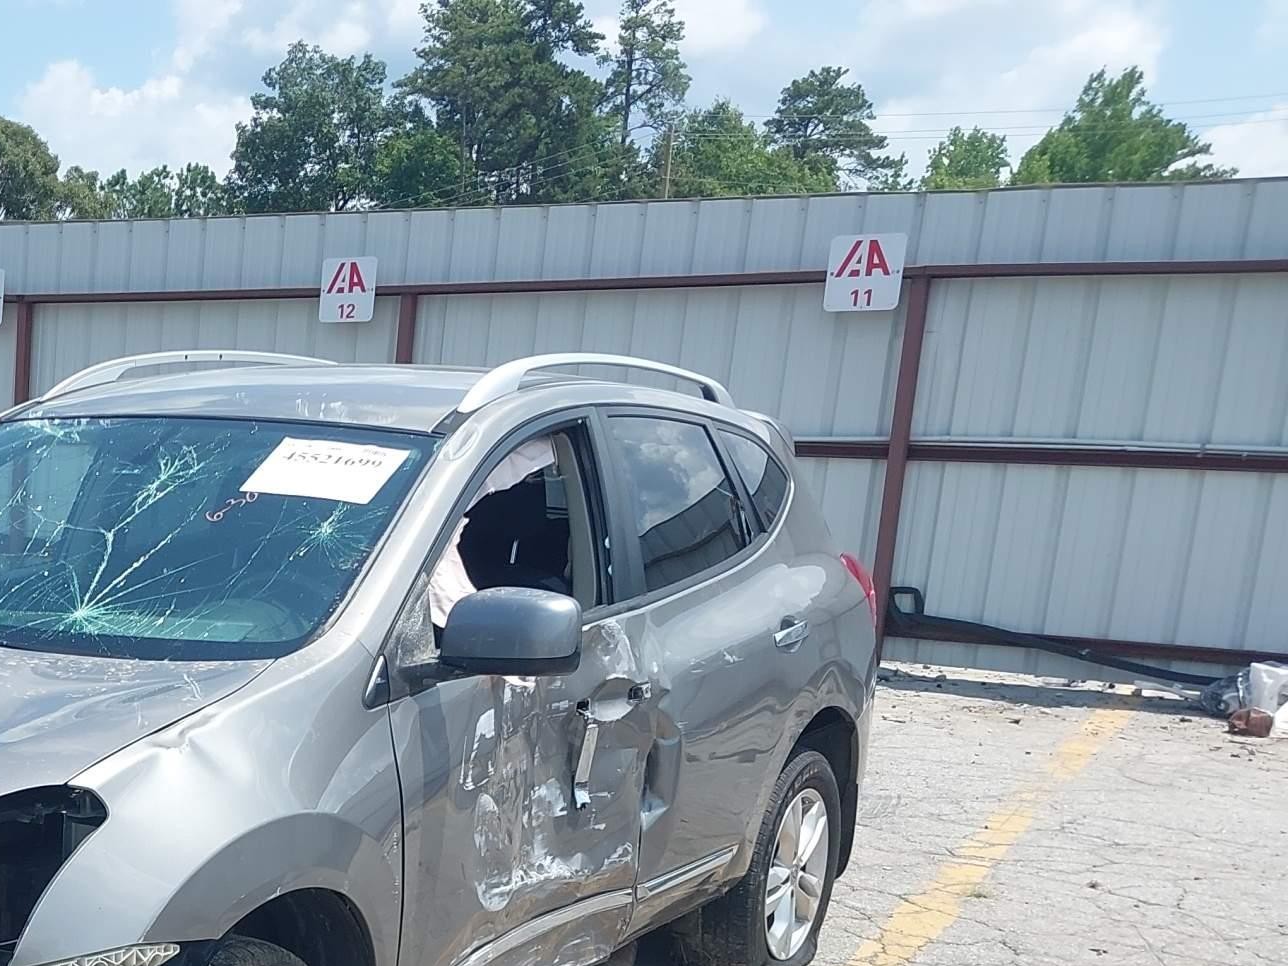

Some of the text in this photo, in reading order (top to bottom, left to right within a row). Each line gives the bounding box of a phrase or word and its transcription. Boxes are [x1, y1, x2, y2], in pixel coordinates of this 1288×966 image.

[850, 288, 873, 307] 11
[338, 303, 356, 319] 12
[283, 451, 383, 468] 45521699
